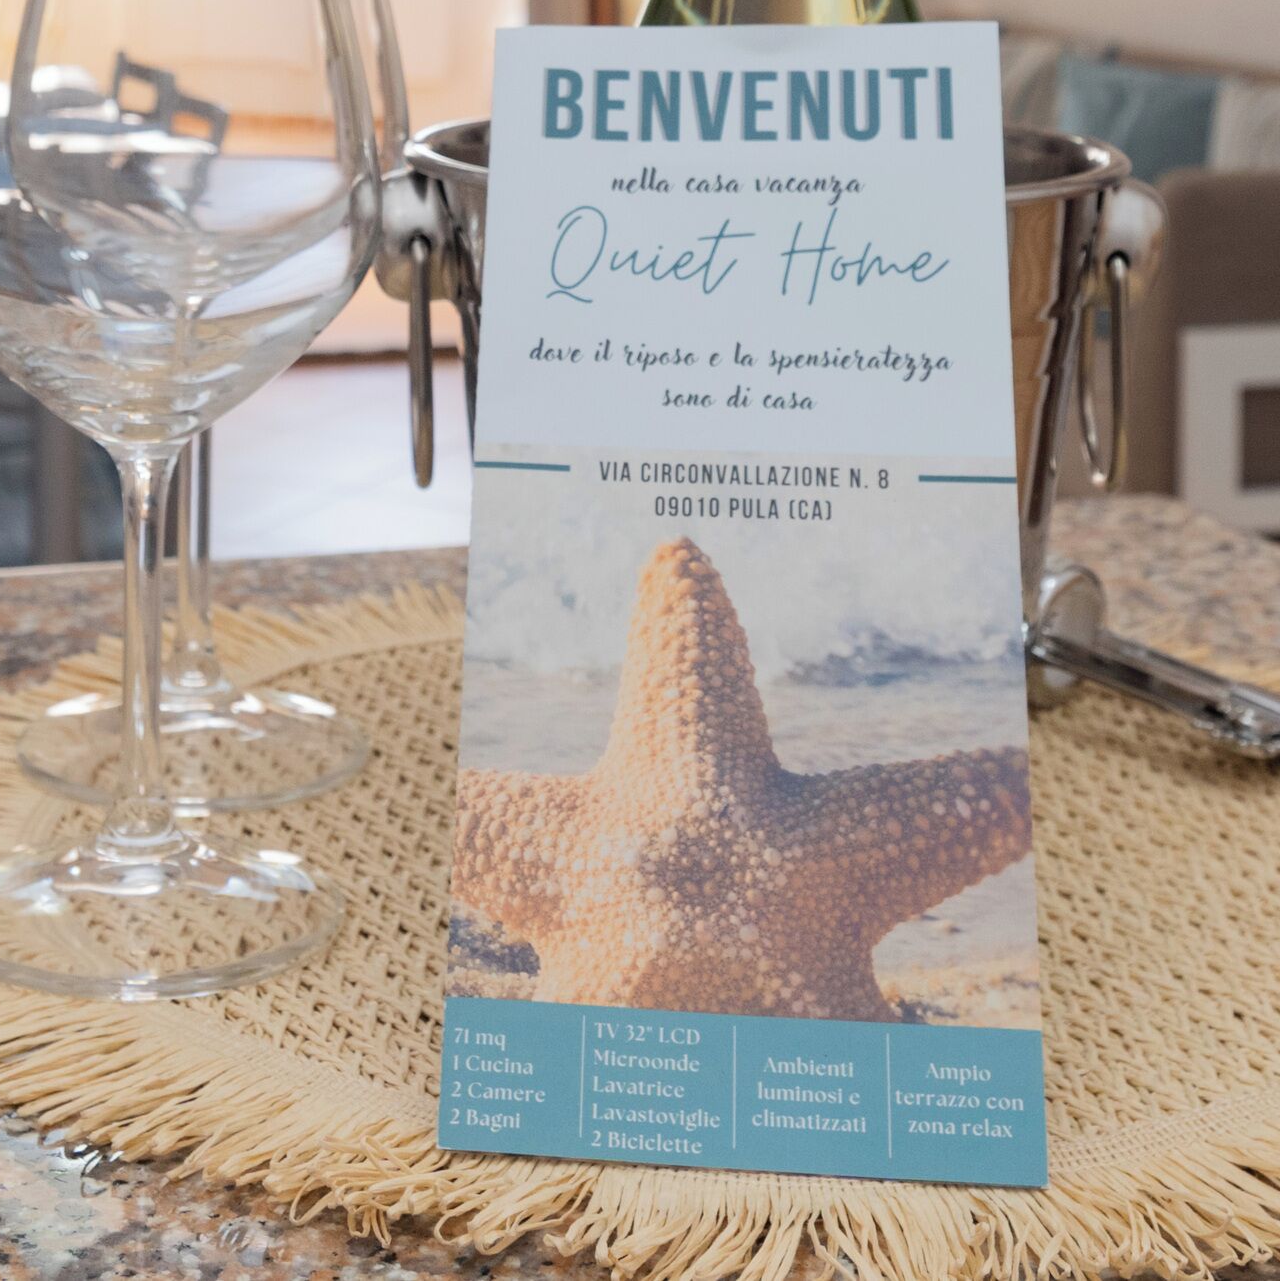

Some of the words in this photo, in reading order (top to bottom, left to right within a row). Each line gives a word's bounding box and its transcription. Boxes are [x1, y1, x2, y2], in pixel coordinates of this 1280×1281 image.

[541, 67, 955, 143] BENVENUTI
[611, 166, 672, 194] nella
[685, 174, 740, 194] casa
[754, 175, 864, 206] vacanza
[545, 205, 756, 304] Quiet
[781, 207, 951, 306] Home
[529, 337, 583, 364] dove
[594, 338, 613, 363] il
[623, 342, 699, 372] riposo
[709, 352, 723, 369] e
[733, 342, 757, 369] la
[768, 344, 954, 382] spensieratezza
[662, 388, 716, 408] sono
[726, 385, 752, 409] di
[762, 390, 818, 411] casa
[598, 460, 632, 483] VIA
[640, 461, 841, 489] CIRCONVALLAZIONE
[849, 468, 870, 490] N.
[877, 468, 890, 490] 8
[654, 495, 720, 519] 09010
[728, 497, 780, 520] PULA
[788, 499, 833, 521] (CA)
[453, 1027, 470, 1045] 71
[475, 1032, 507, 1052] mq
[593, 1021, 620, 1040] TV
[626, 1024, 654, 1043] 32"
[658, 1026, 702, 1046] LCD
[452, 1054, 460, 1071] 1
[465, 1054, 535, 1076] Cucina
[593, 1048, 701, 1073] Microonde
[762, 1055, 855, 1079] Ambienti
[592, 1075, 686, 1099] Lavatrice
[925, 1062, 992, 1087] Ampio
[450, 1081, 462, 1099] 2
[467, 1081, 547, 1104] Camere
[757, 1081, 844, 1105] luminosi
[848, 1091, 862, 1107] e
[895, 1088, 981, 1110] terrazzo
[986, 1095, 1025, 1112] con
[449, 1107, 461, 1126] 2
[465, 1108, 522, 1134] Bagni
[591, 1102, 721, 1132] Lavastoviglie
[751, 1108, 868, 1135] climatizzati
[907, 1118, 957, 1136] zona
[961, 1118, 1014, 1139] relax
[591, 1130, 603, 1148] 2
[607, 1131, 704, 1155] Biciclette
